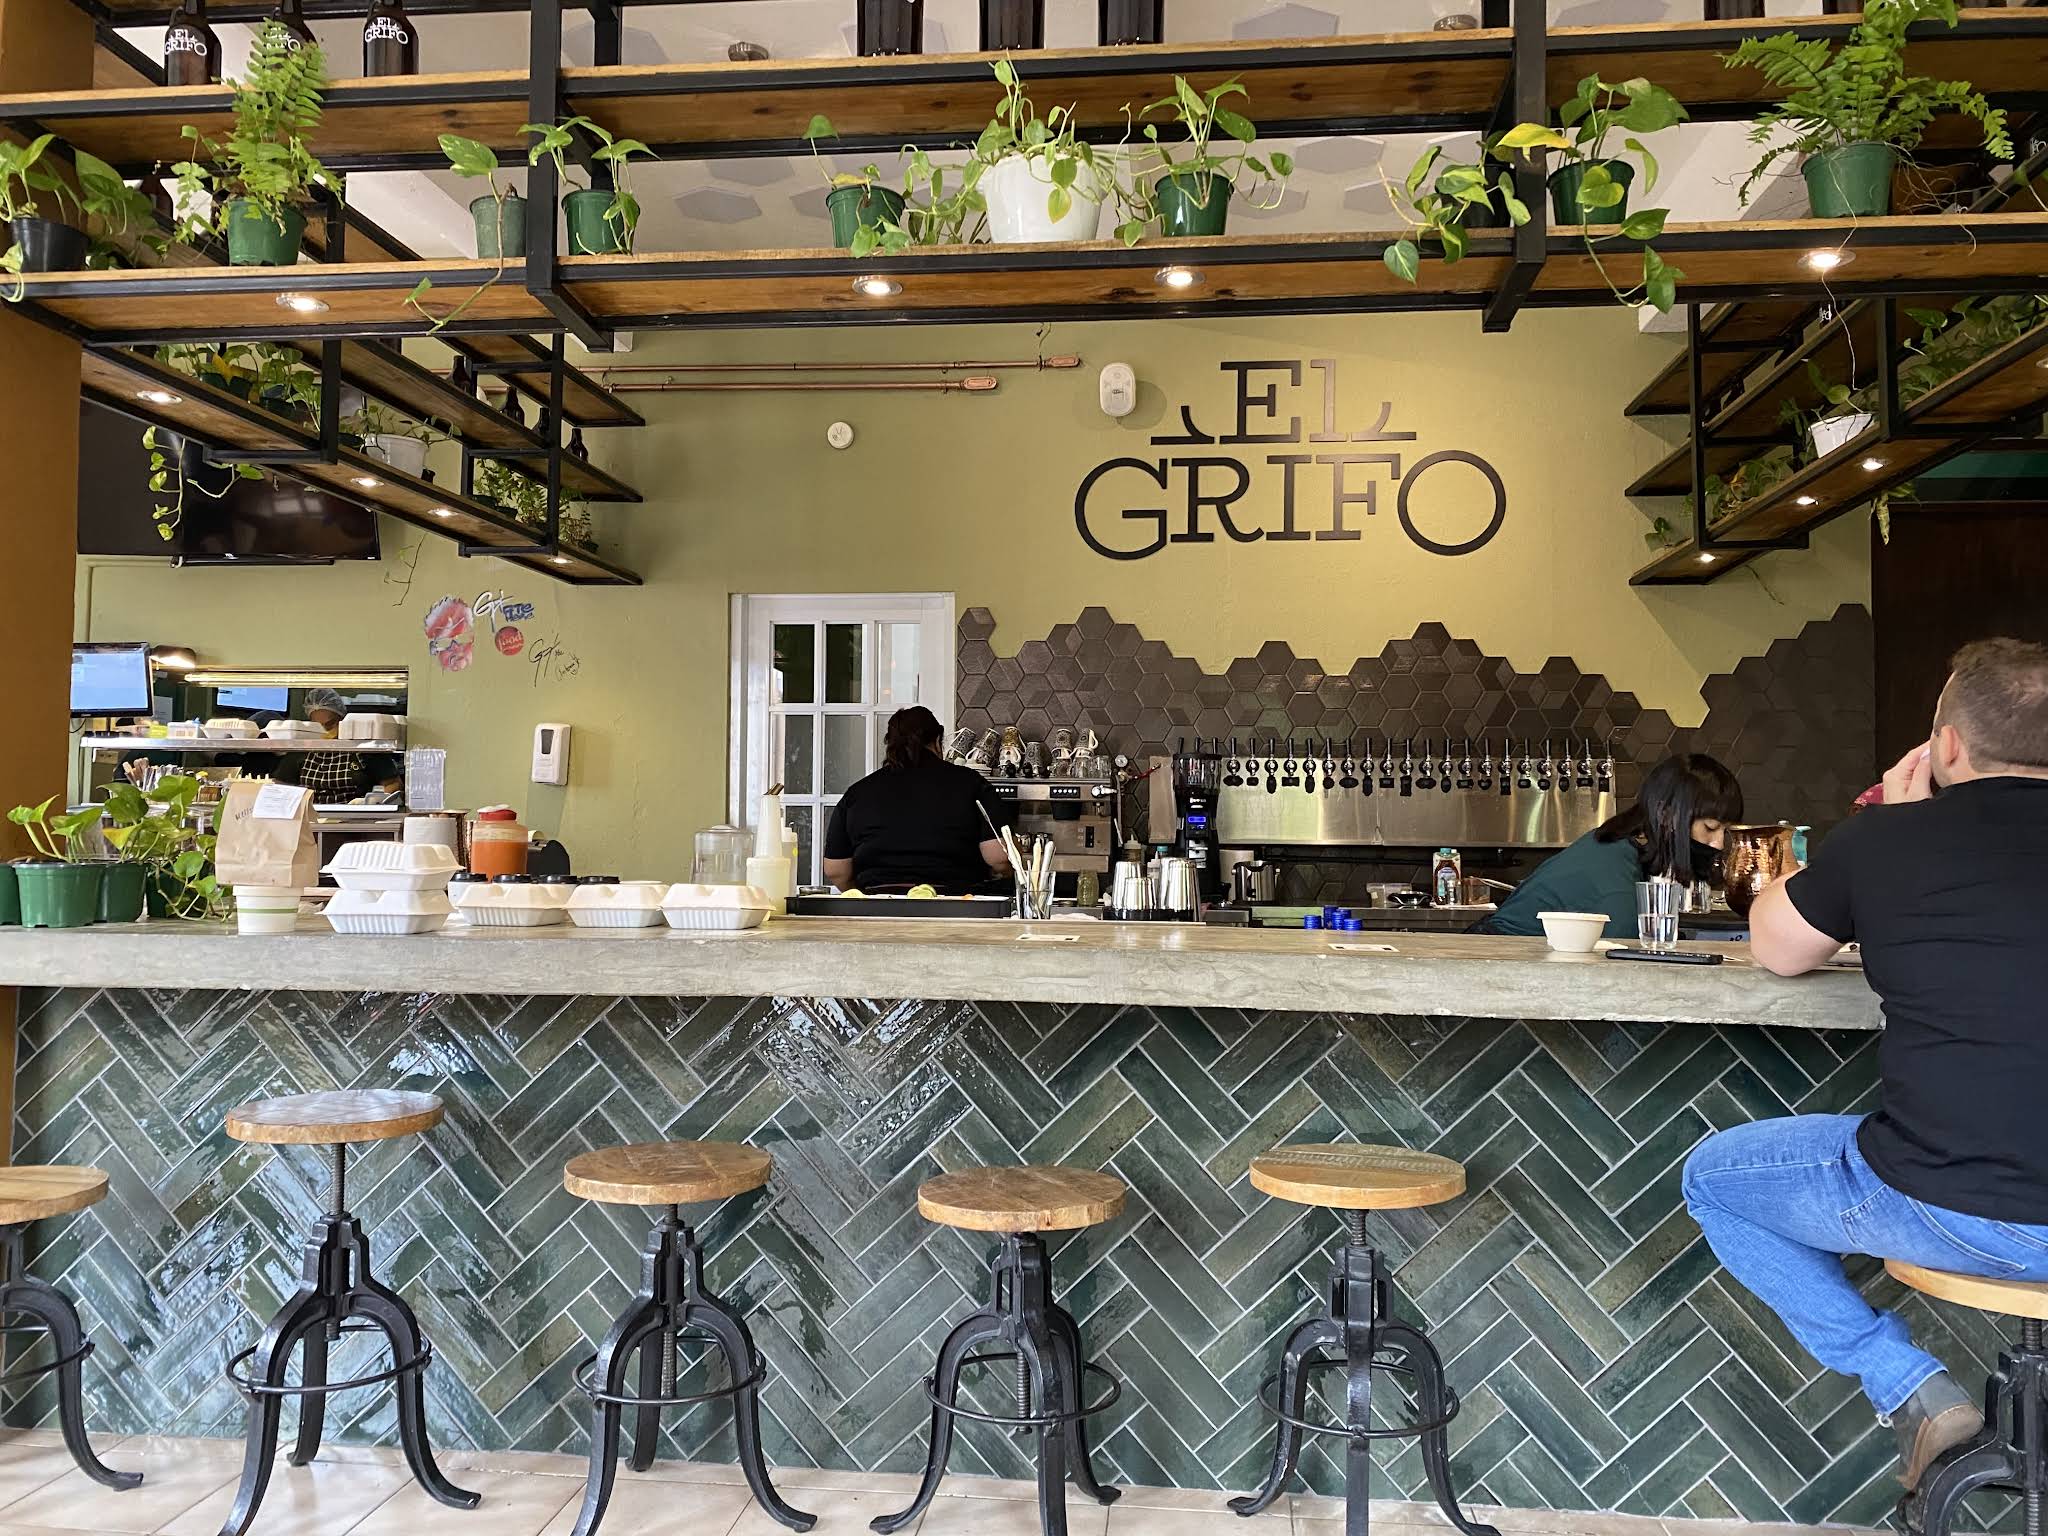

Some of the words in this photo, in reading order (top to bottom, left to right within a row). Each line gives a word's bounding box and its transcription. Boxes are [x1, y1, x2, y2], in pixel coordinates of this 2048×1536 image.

[365, 27, 409, 45] GRIFO
[164, 39, 207, 57] GRIFO
[1074, 449, 1507, 561] GRIFO
